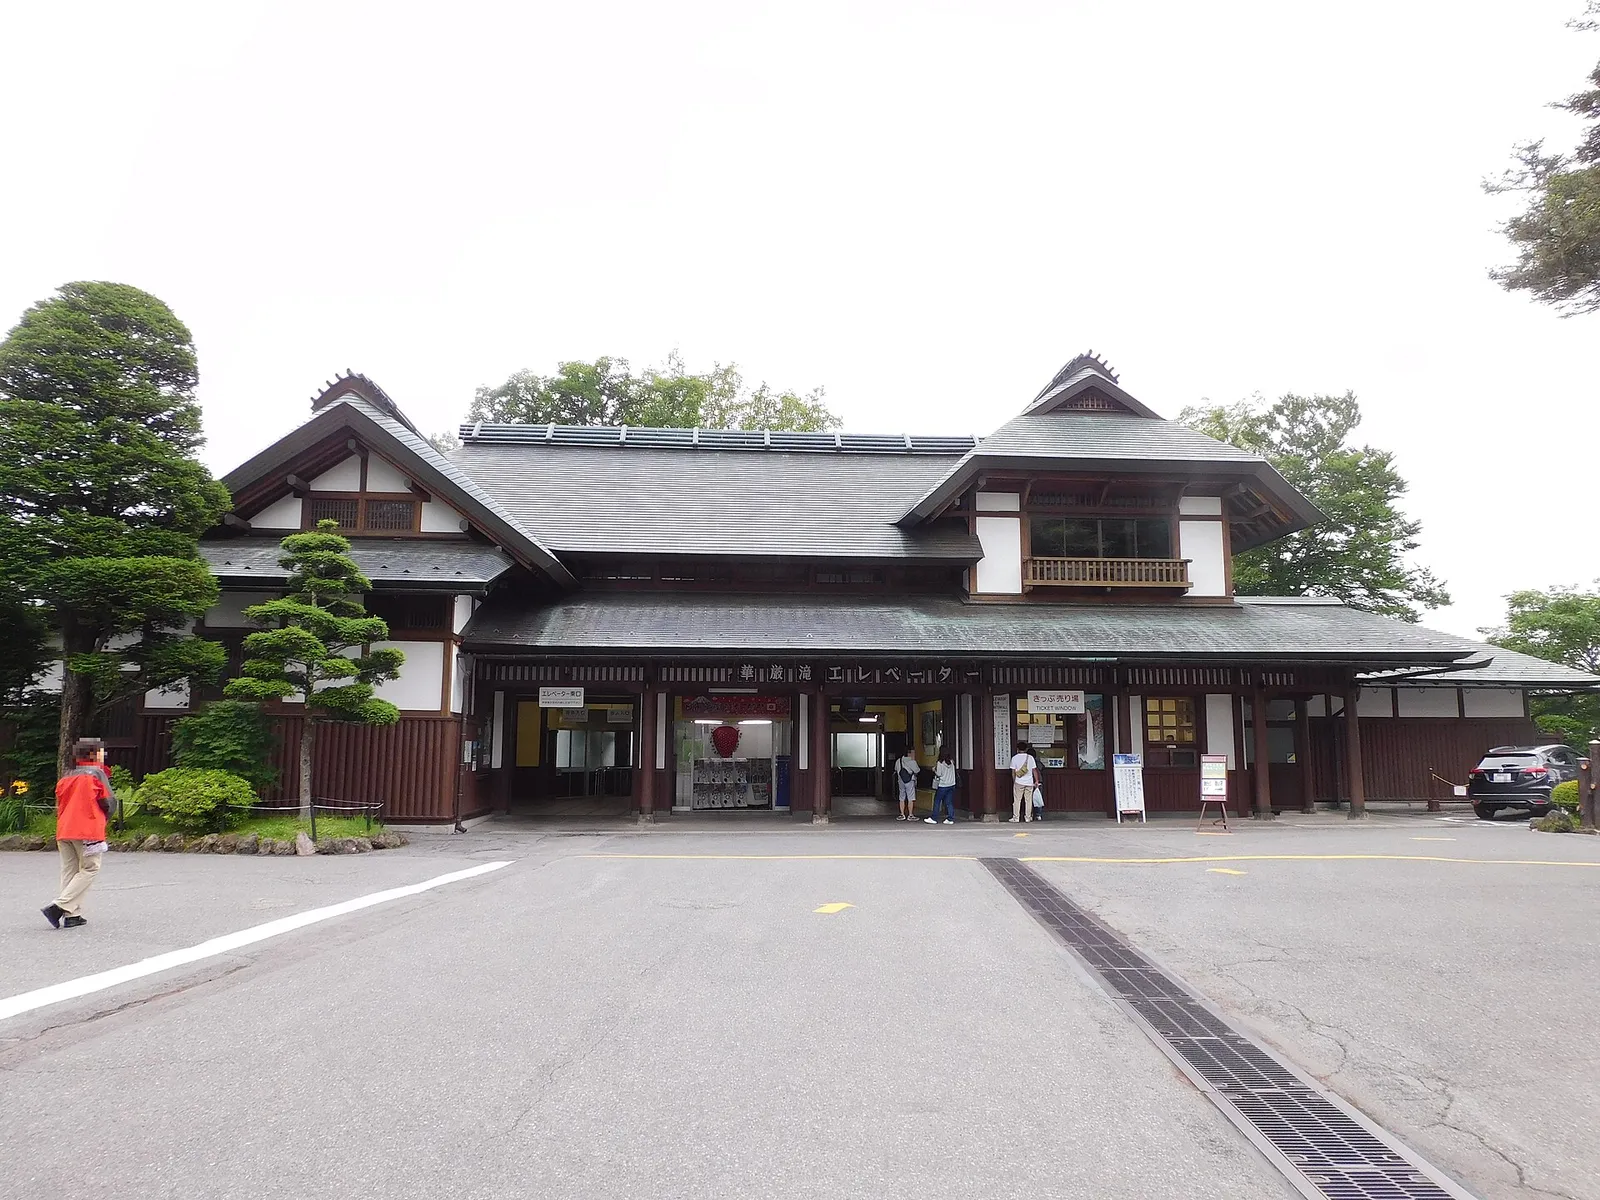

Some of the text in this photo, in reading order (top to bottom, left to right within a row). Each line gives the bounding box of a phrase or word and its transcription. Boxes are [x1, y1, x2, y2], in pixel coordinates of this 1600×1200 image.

[740, 664, 979, 681] 華厳滝エレベーター
[1033, 694, 1079, 703] きっぷ売り場
